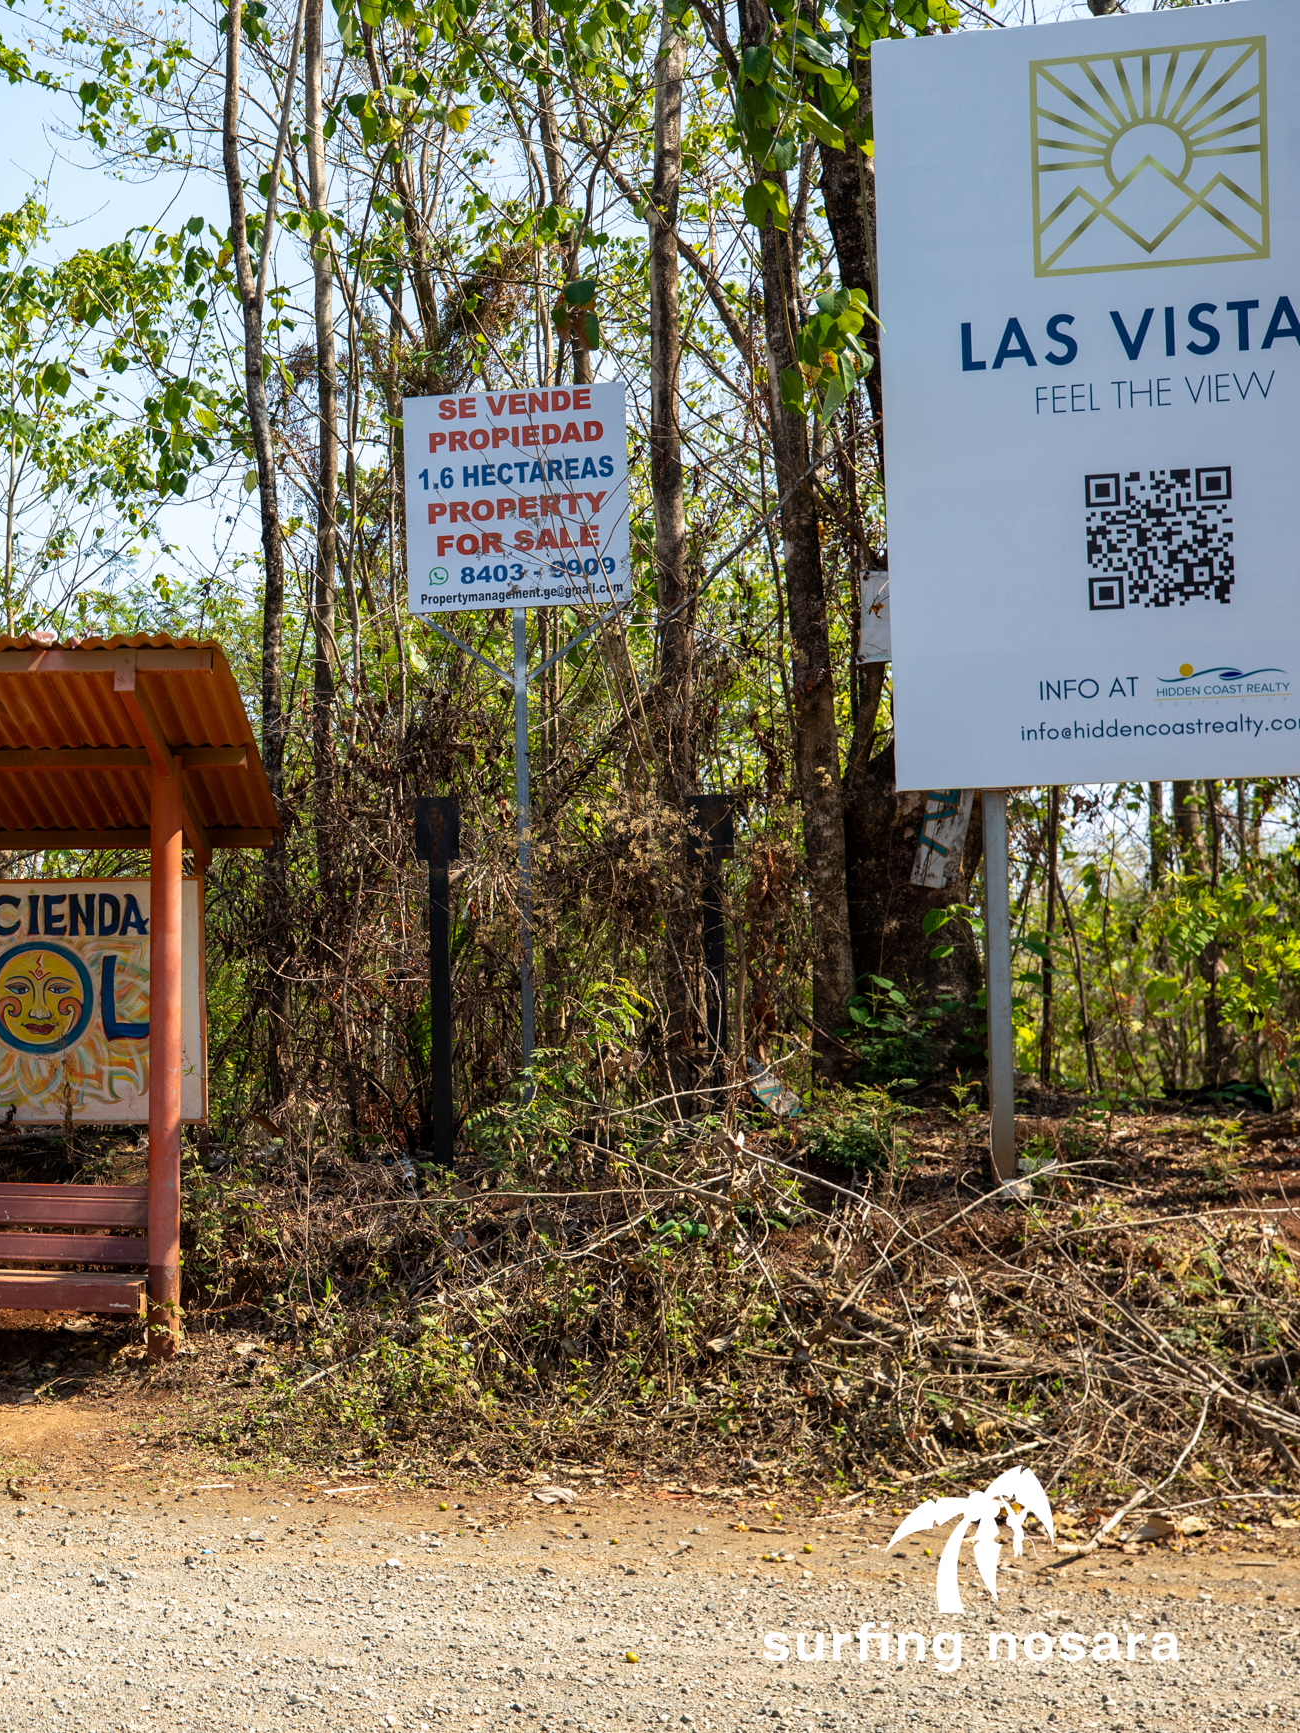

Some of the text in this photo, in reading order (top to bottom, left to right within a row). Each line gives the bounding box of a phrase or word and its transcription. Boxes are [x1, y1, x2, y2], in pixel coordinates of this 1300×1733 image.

[960, 313, 1078, 372] LAS
[438, 388, 592, 420] SE VENDE
[1036, 370, 1275, 415] FEEL THE VIEW
[428, 420, 604, 455] PROPIEDAD
[418, 455, 614, 491] 1.6 HECTAREAS
[427, 490, 608, 525] PROPERTY
[436, 524, 600, 557] FOR SALE
[460, 563, 524, 585] 8403
[550, 556, 616, 580] 9909
[1040, 676, 1139, 701] INFO AT
[1156, 682, 1290, 697] HIDDEN COAST REALTY
[1158, 699, 1220, 708] COSTA
[1021, 713, 1300, 741] info@hiddencoastrealty.co
